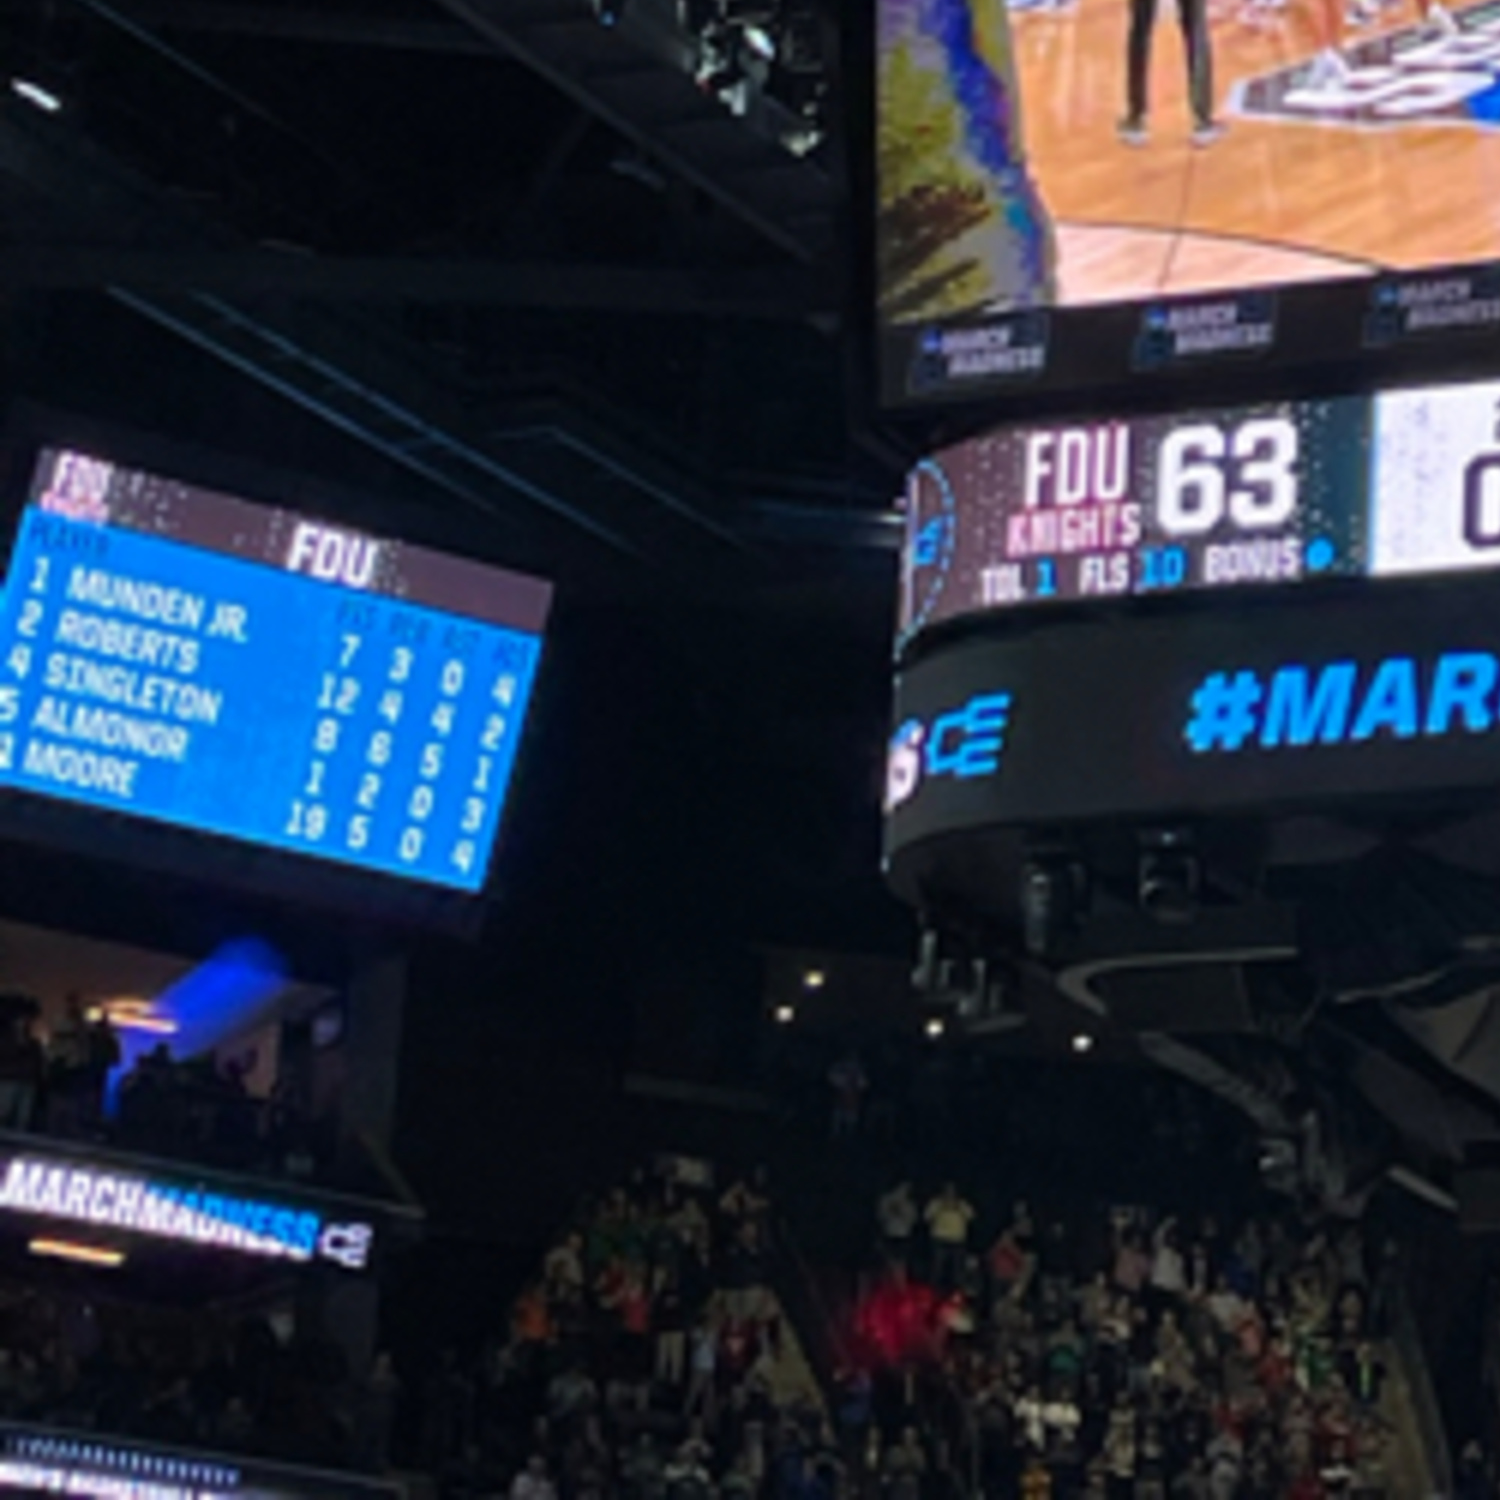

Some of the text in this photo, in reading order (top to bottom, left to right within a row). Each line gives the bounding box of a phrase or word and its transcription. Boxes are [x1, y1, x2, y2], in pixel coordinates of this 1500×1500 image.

[1007, 504, 1141, 558] KNIGHTS
[1025, 419, 1298, 535] FDU 63
[287, 520, 380, 589] FDU
[981, 540, 1299, 605] TOL 1 FLS 10 BONUS
[17, 601, 505, 751] 2 ROBERTS 12 4 4 2
[29, 556, 49, 593] 1
[66, 564, 204, 628] MUNDEN
[340, 633, 361, 668] 7
[389, 646, 413, 682] 3
[441, 659, 464, 696] 0
[491, 673, 516, 709] 4
[6, 644, 31, 679] 4
[44, 653, 223, 726] SINGLETON
[316, 718, 339, 753] 8
[420, 743, 443, 779] 5
[473, 756, 491, 791] 1
[30, 696, 189, 763] ALMONOR
[305, 761, 325, 796] 1
[356, 773, 380, 809] 2
[409, 785, 433, 821] 0
[460, 797, 485, 833] 3
[24, 739, 139, 798] MOORE
[285, 801, 327, 841] 19
[347, 814, 370, 849] 5
[400, 827, 423, 862] 0
[451, 839, 475, 874] 4
